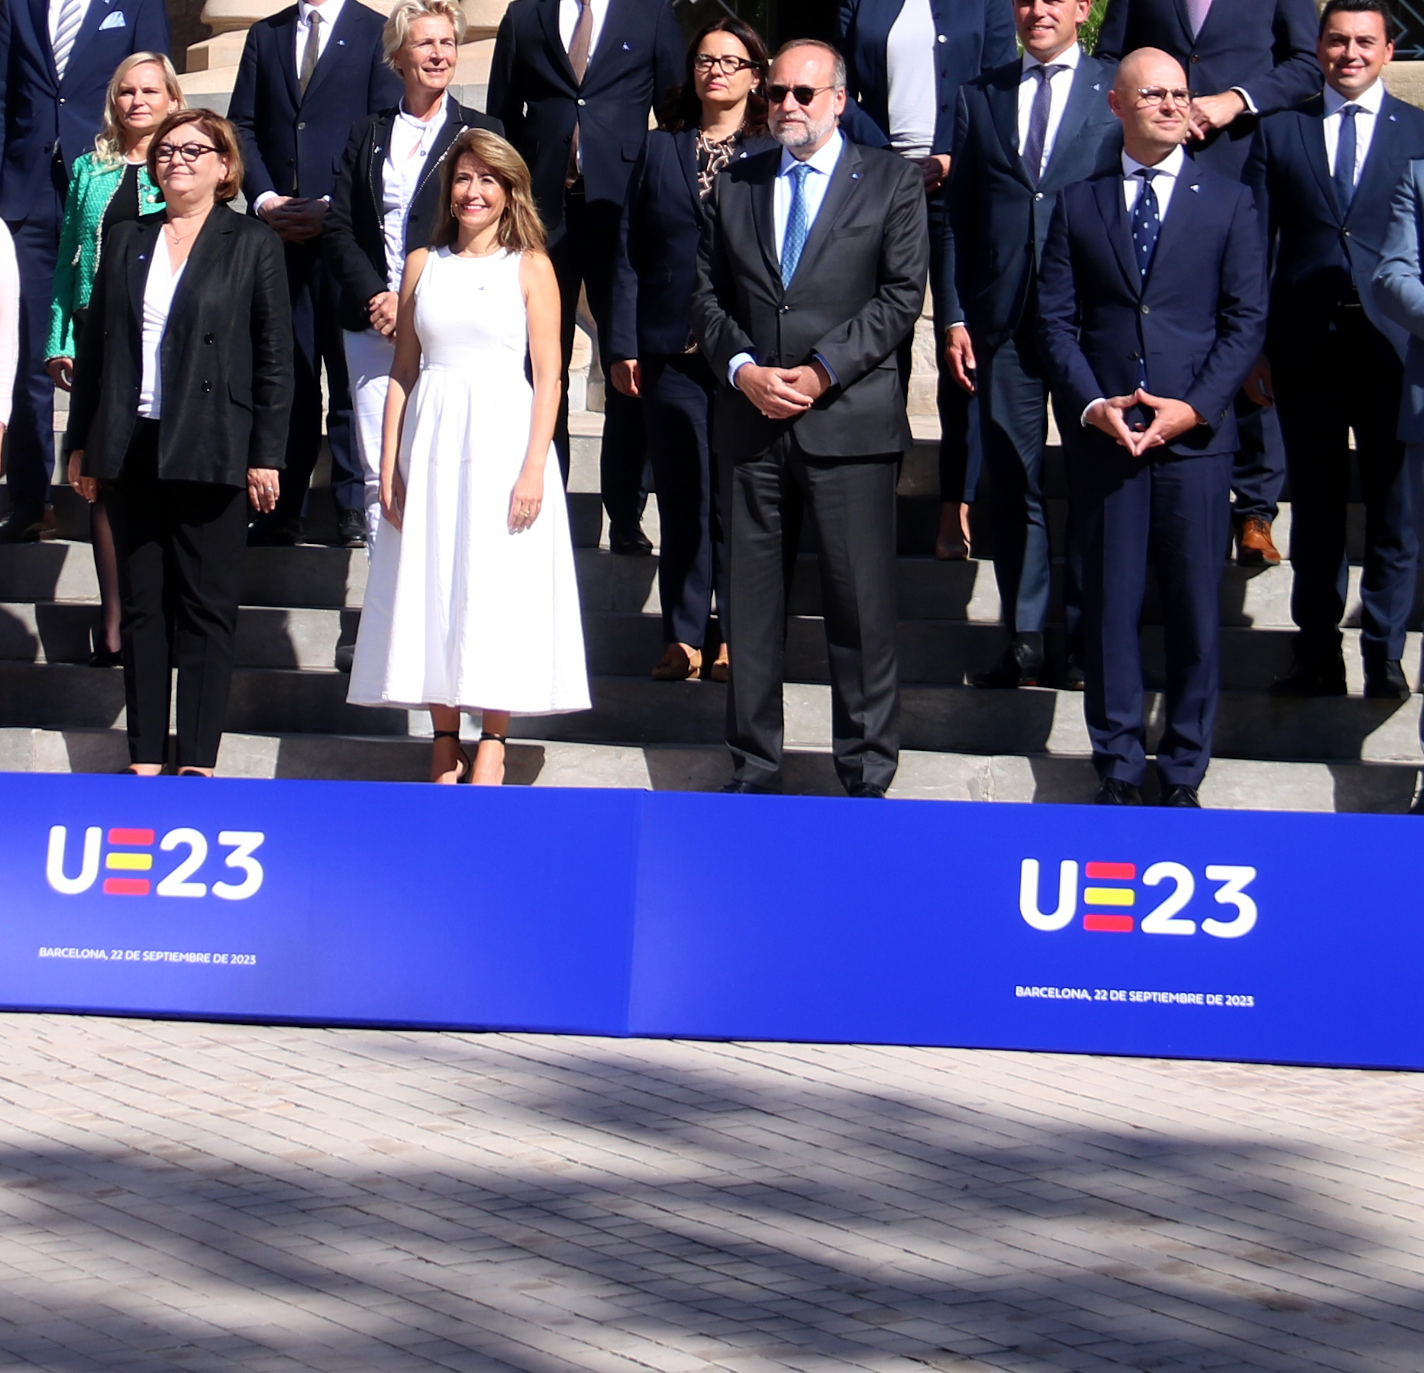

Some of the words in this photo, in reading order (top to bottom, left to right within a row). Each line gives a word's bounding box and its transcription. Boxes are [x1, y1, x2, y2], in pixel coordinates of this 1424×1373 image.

[46, 825, 265, 900] UE23
[1019, 858, 1258, 938] UE23
[38, 946, 109, 961] BARCELONA,
[110, 949, 123, 961] 22
[125, 950, 141, 961] DE
[142, 950, 211, 964] SEPTIEMBRE
[213, 953, 229, 964] DE
[230, 953, 257, 965] 2023
[1015, 985, 1092, 1001] BARCELONA,
[1094, 989, 1108, 1001] 22
[1110, 989, 1127, 1002] DE
[1128, 990, 1204, 1005] SEPTIEMBRE
[1206, 993, 1223, 1006] DE
[1225, 994, 1255, 1007] 2023
